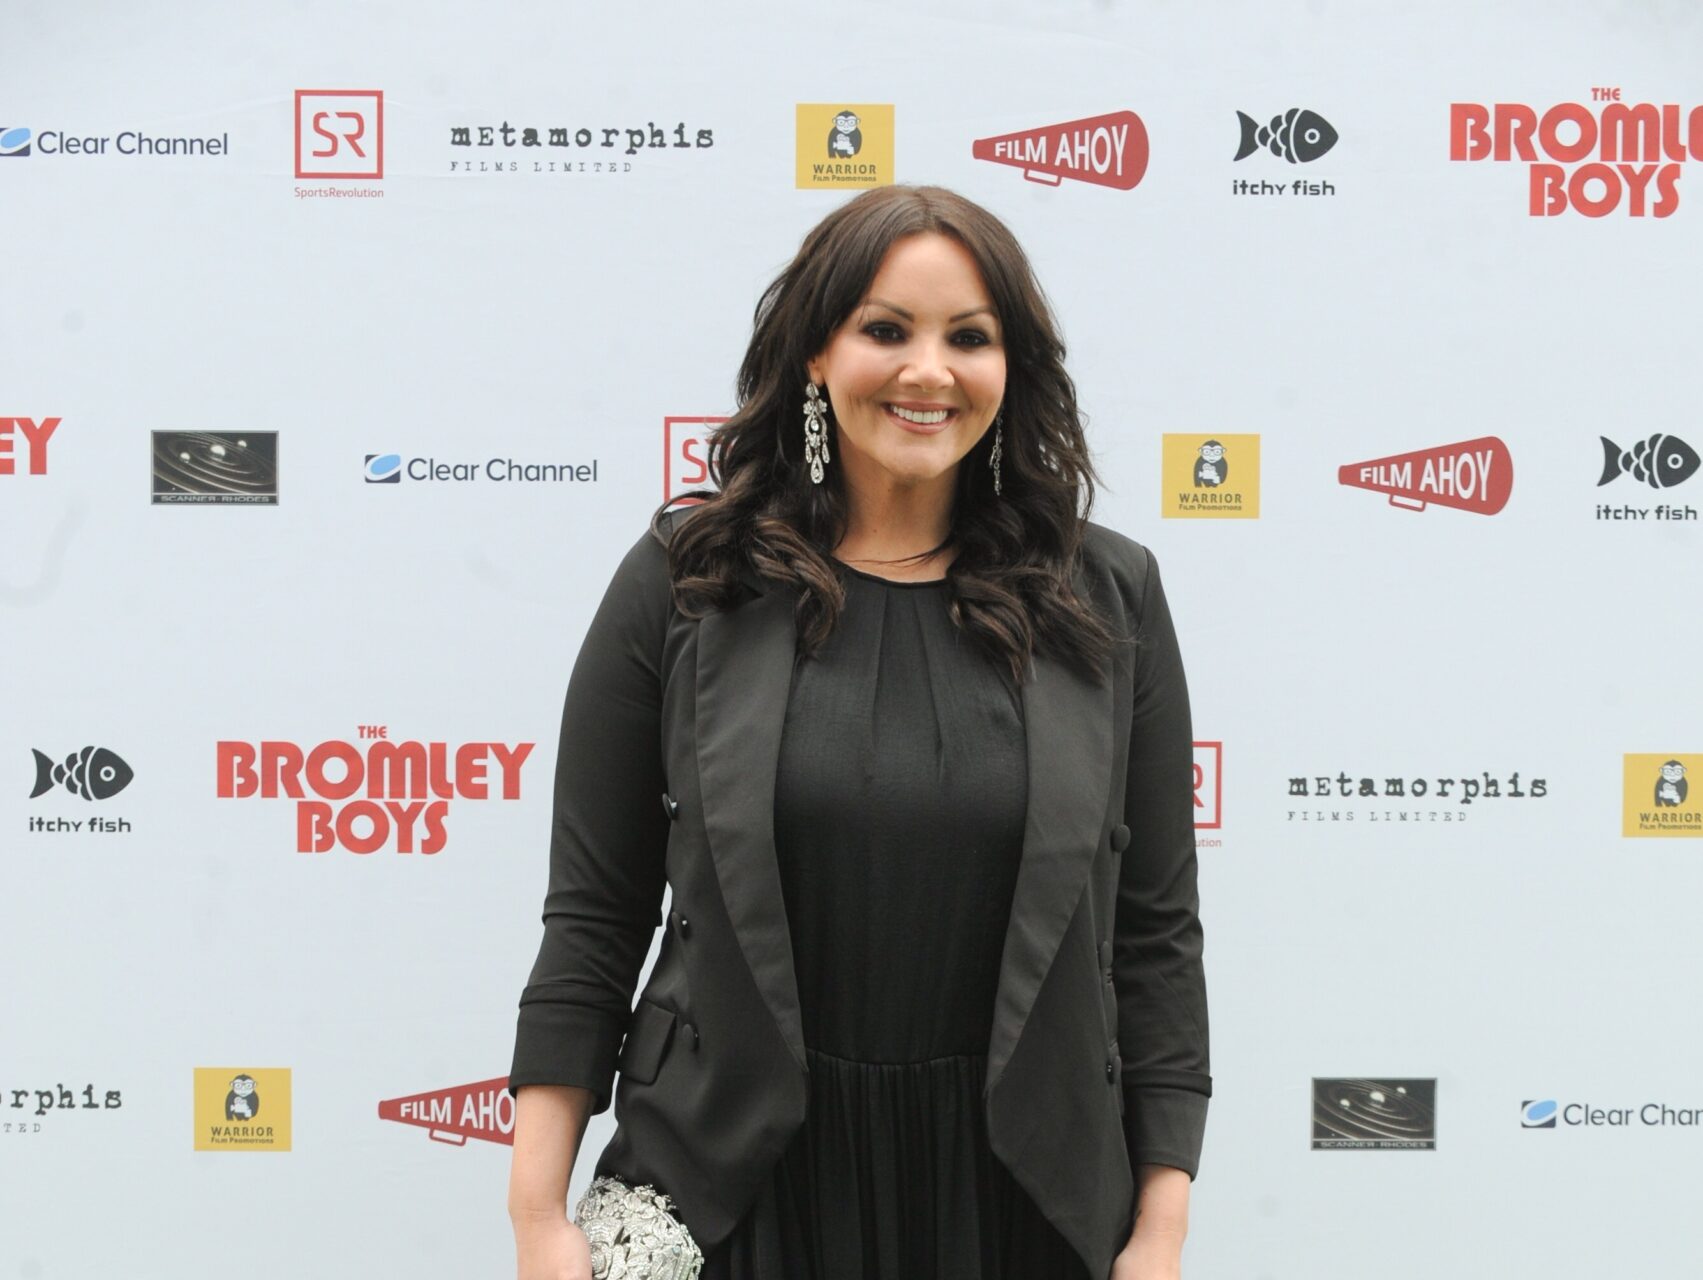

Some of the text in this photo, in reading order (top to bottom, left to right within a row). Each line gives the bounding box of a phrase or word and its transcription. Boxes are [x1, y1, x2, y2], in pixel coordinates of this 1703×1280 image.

[1591, 88, 1620, 101] THE
[313, 112, 366, 157] SR
[37, 131, 227, 155] Clear Channel
[995, 124, 1128, 176] FILM AHOY
[451, 161, 631, 172] FILMS LIMITED
[813, 164, 876, 174] WARRIOR
[294, 187, 384, 199] SportsRevolution
[1233, 180, 1335, 195] itchy fish
[1529, 162, 1680, 218] BOYS
[408, 458, 597, 482] Clear Channel
[1361, 450, 1492, 501] FILM AHOY
[1179, 493, 1241, 503] WARRIOR
[1597, 505, 1697, 520] itchy fish
[358, 726, 386, 739] THE
[217, 740, 535, 800] BROMLEY
[1288, 811, 1466, 821] FILMS LIMITED
[1640, 813, 1701, 822] WARRIOR
[30, 817, 131, 832] itchy fish
[297, 800, 448, 855] BOYS
[401, 1097, 451, 1124] FILM
[1563, 1104, 1634, 1125] Clear
[211, 1127, 273, 1137] WARRIOR
